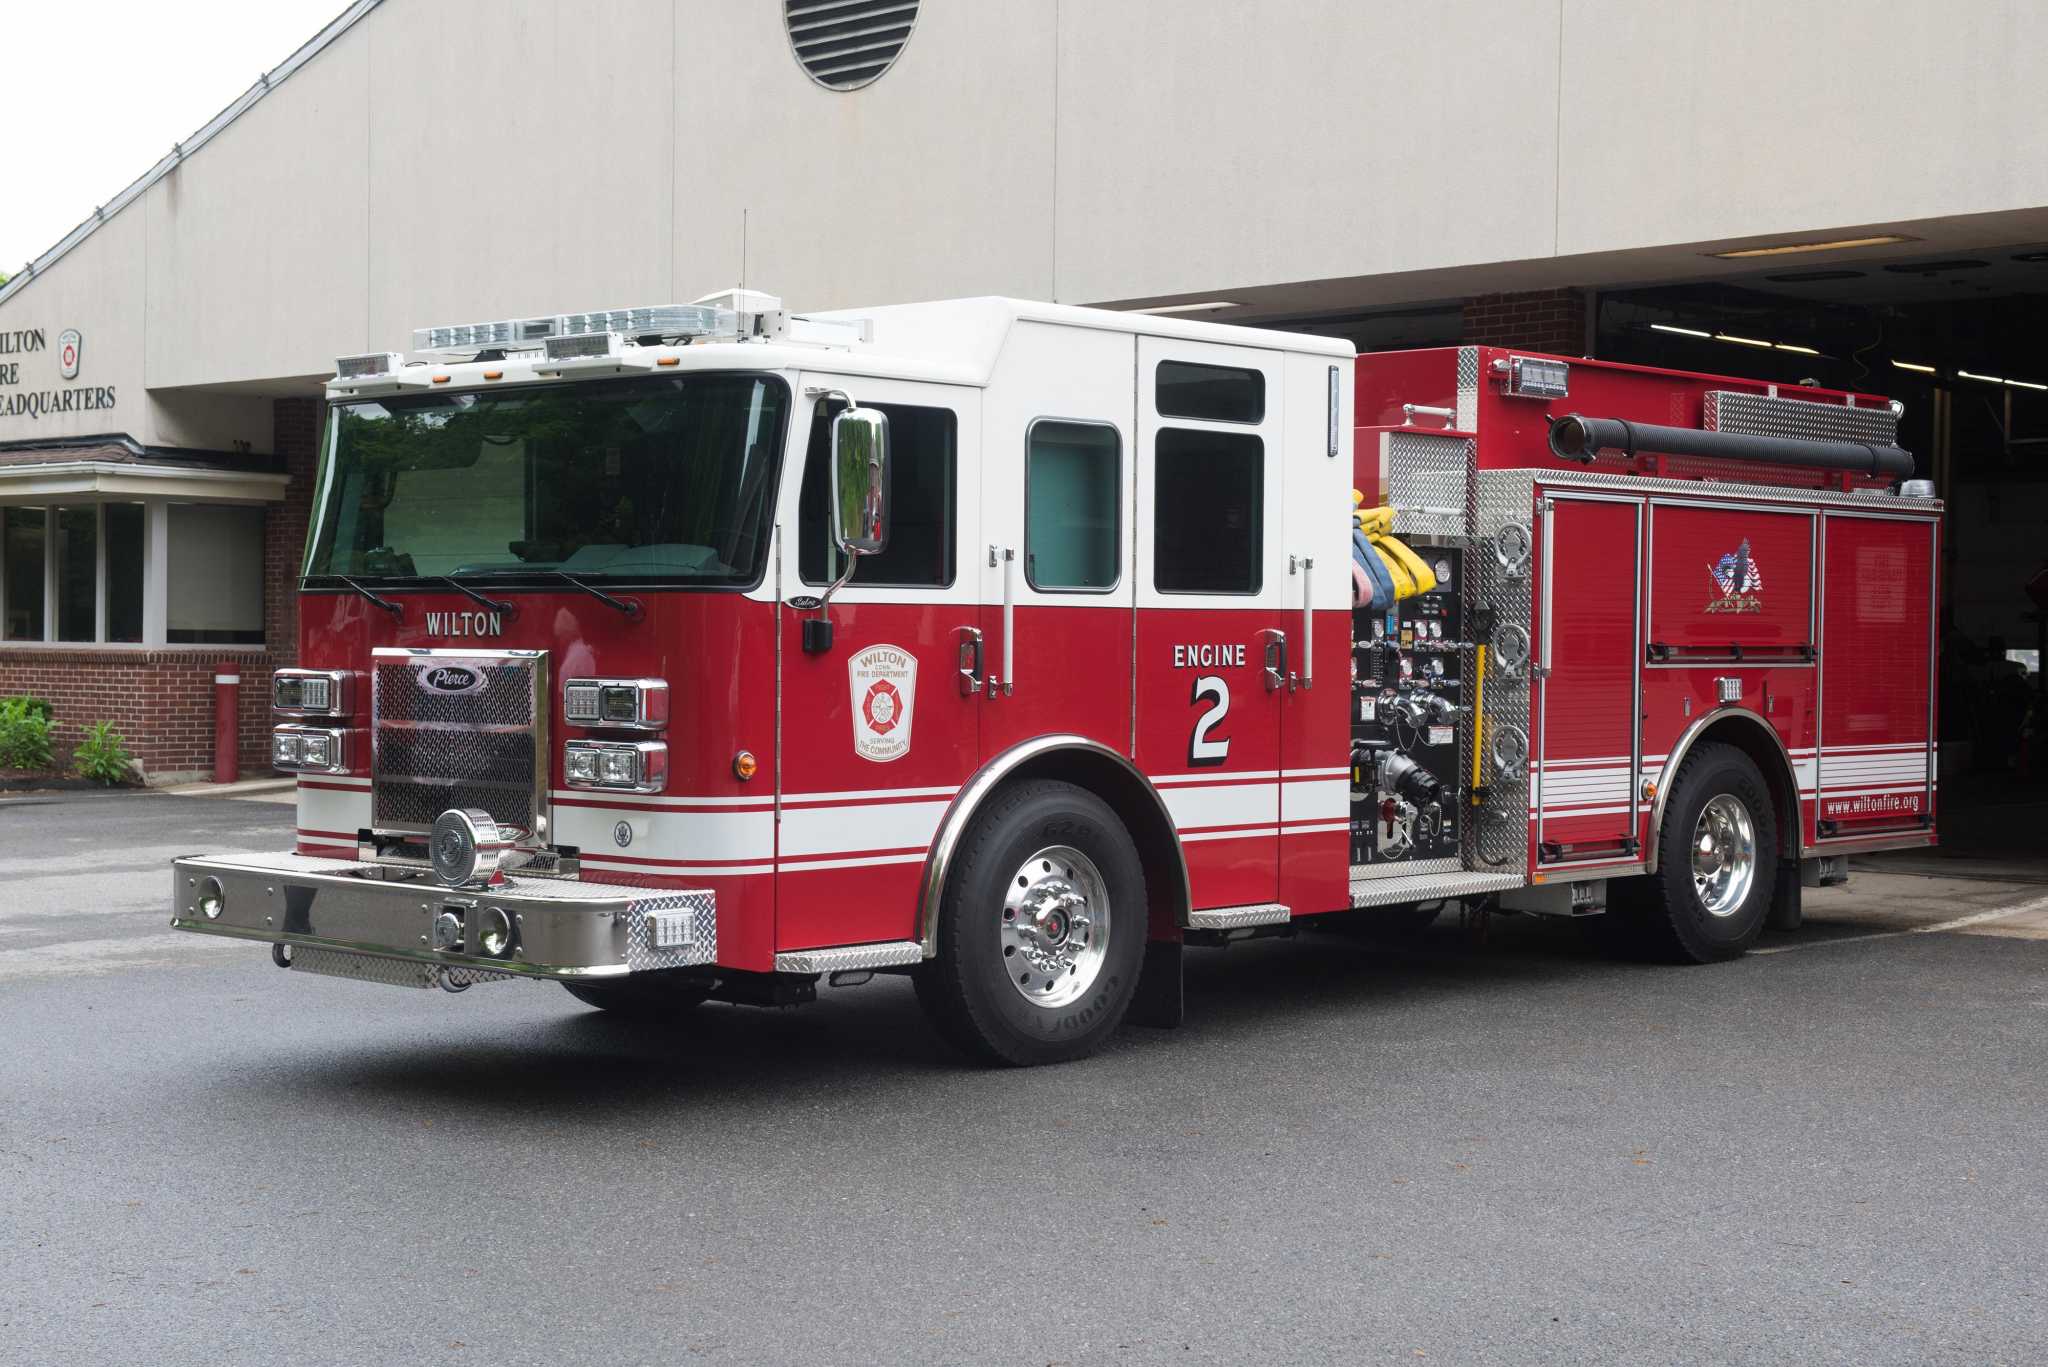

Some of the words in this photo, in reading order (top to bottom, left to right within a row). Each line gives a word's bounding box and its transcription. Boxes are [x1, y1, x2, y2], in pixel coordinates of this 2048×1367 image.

[425, 611, 501, 636] WILTON
[860, 651, 907, 668] WILTON
[1173, 644, 1246, 667] ENGINE
[433, 668, 470, 688] Pierce
[1188, 675, 1230, 766] 2
[1827, 794, 1919, 815] www.wiltonfire.org
